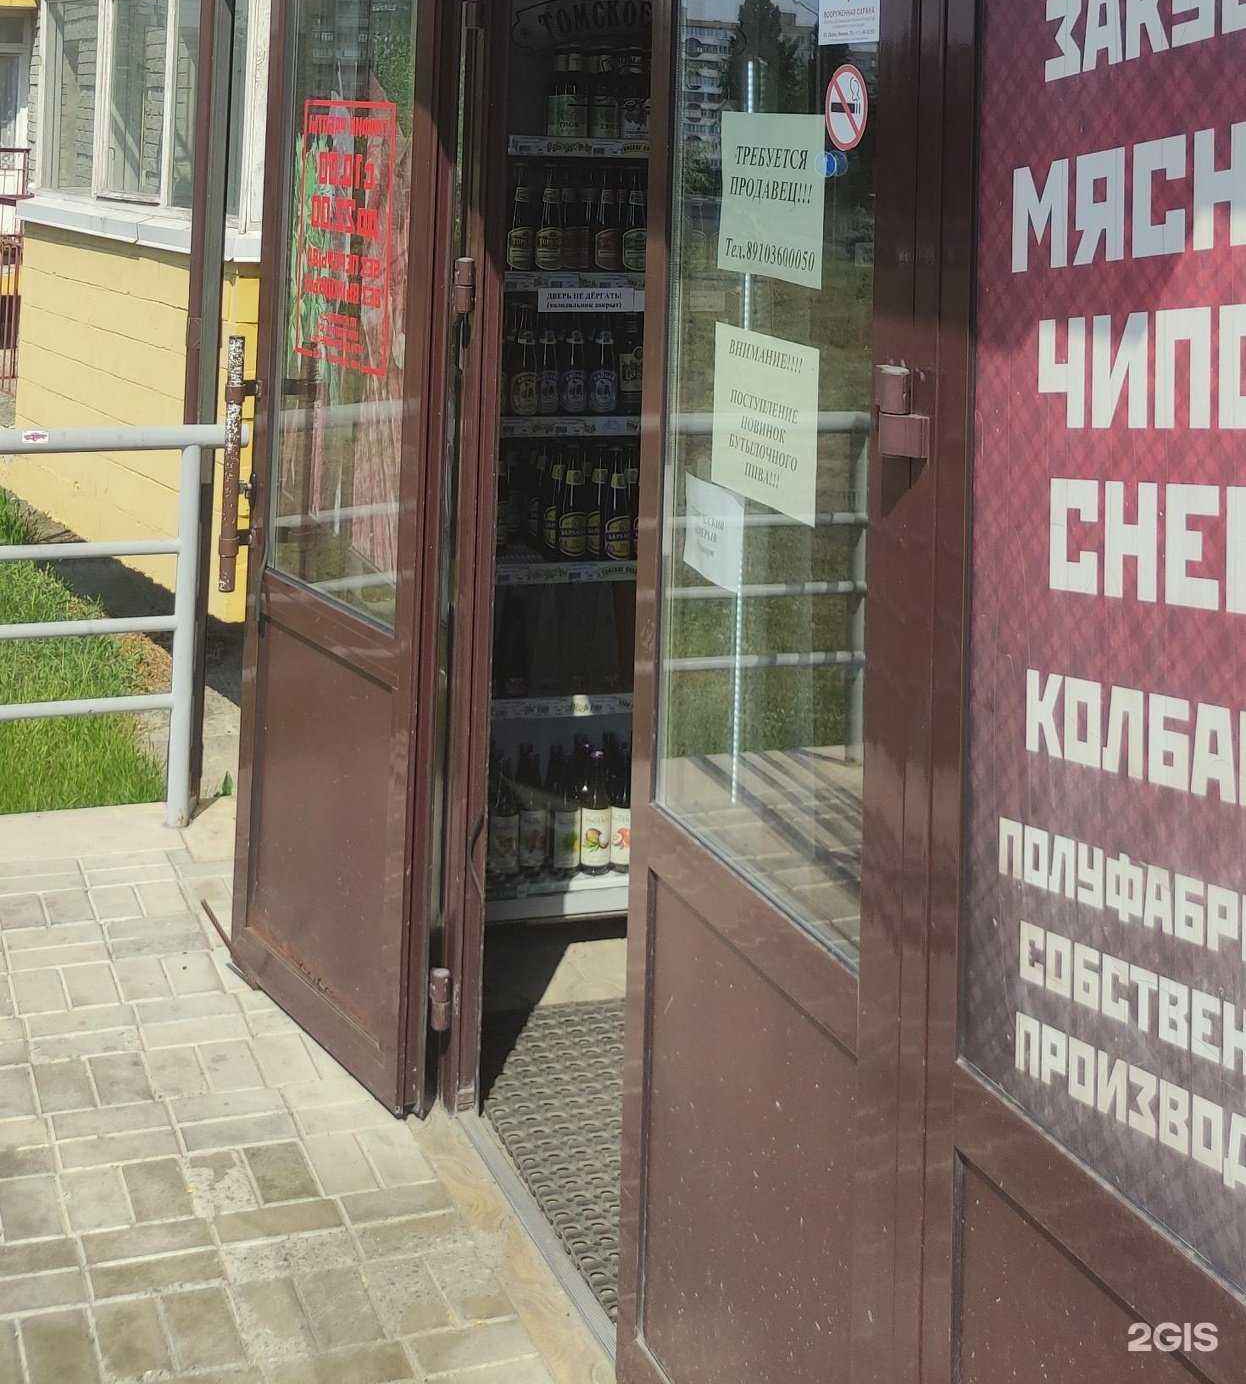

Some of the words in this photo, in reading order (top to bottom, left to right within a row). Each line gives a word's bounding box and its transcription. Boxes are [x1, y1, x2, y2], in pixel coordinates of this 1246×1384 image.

[736, 145, 808, 170] ТРЕБУЕТСЯ
[730, 176, 814, 206] ПРОДАВЕЦ!!!
[1011, 121, 1246, 273] МЯСН
[730, 389, 800, 425] ПОСТУПЛЕНИЕ
[741, 415, 787, 444] НОВИНОК
[728, 433, 799, 472] БУТЫЛОЧНОГО
[1025, 668, 1246, 806] КОЛБА
[999, 816, 1246, 962] ПОЛУФАБР
[1019, 920, 1246, 1076] СОБСТВЕН
